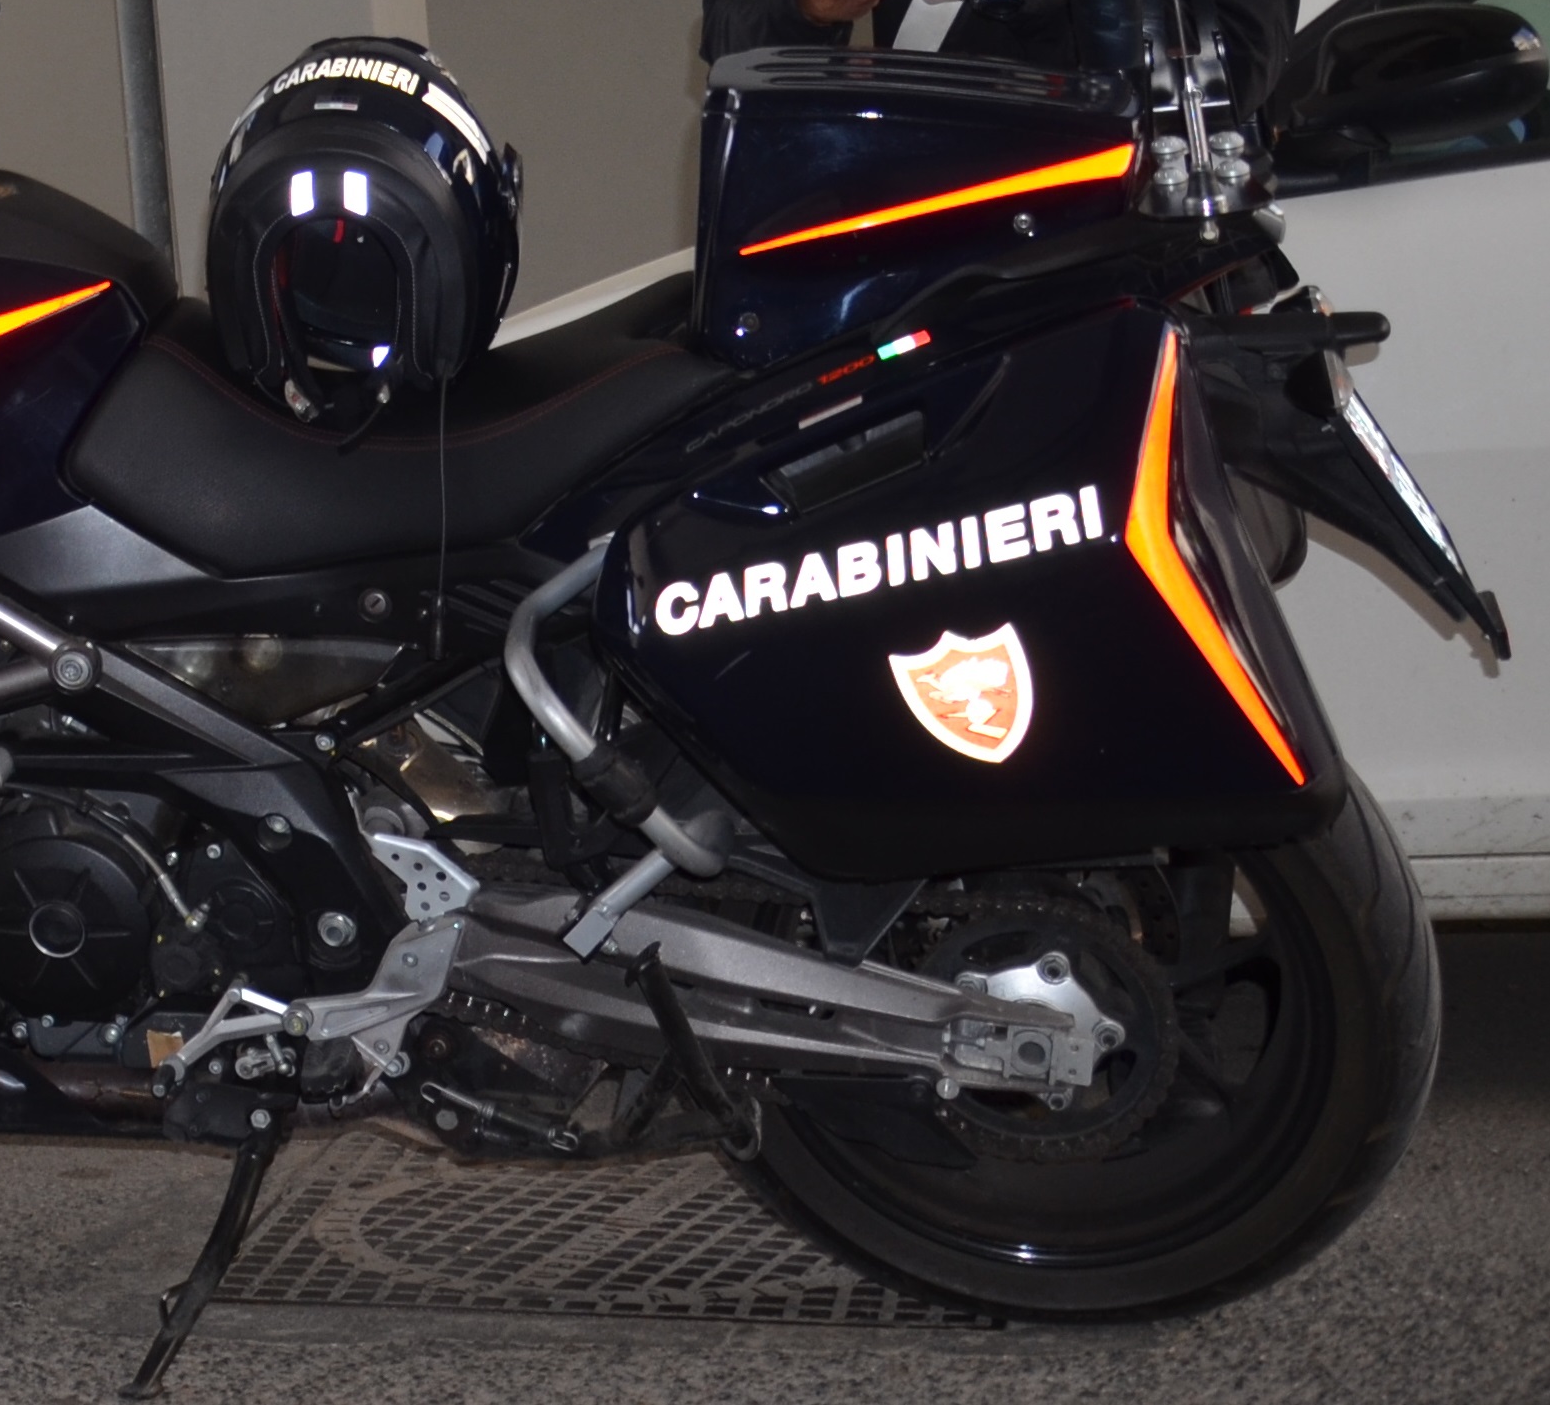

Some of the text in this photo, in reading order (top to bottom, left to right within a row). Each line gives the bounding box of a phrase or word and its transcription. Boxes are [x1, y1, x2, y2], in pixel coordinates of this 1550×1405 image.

[273, 57, 420, 95] CARABINIERI
[816, 354, 876, 385] 1200
[655, 485, 1103, 636] CARABINIERI
